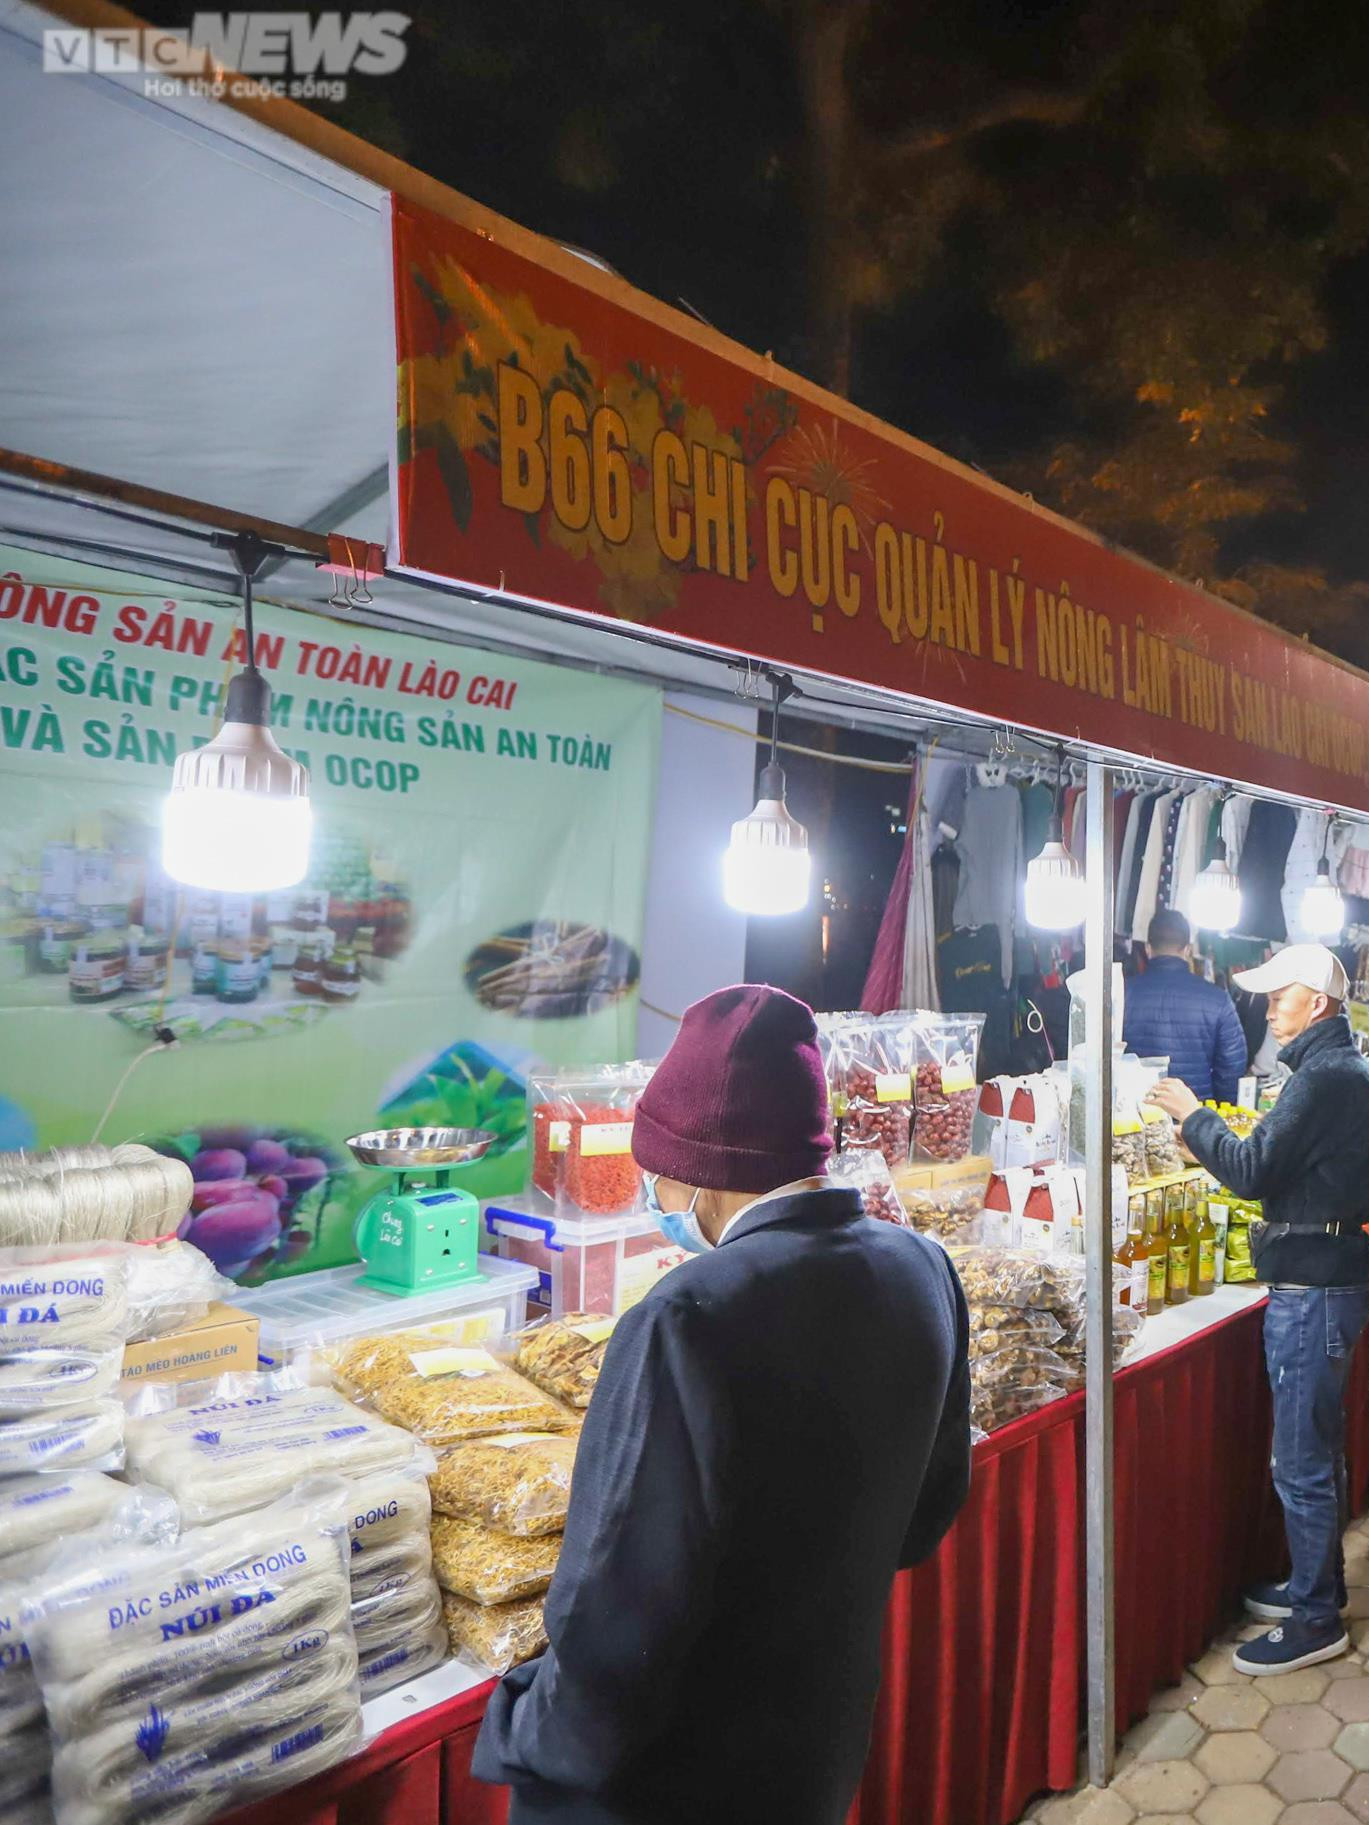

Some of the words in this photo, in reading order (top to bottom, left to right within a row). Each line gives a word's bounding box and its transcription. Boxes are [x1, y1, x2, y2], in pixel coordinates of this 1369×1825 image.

[498, 360, 632, 545] B66
[653, 429, 748, 582] CHI
[766, 477, 861, 633] CỤC
[874, 511, 981, 657] QUẢN
[989, 557, 1025, 671] LÝ
[1035, 580, 1115, 700] NÔNG
[1120, 614, 1172, 719] LÂM
[113, 600, 214, 657] SẢN
[221, 627, 285, 670] AN
[297, 641, 392, 690] TOÀN
[397, 658, 460, 700] LÀO
[466, 675, 517, 710] CAI
[1, 704, 64, 753] VÀ
[82, 713, 177, 770] SẢN
[56, 650, 155, 706] SẢN
[170, 675, 294, 728] PHM
[304, 697, 406, 743] NÔNG
[417, 708, 485, 753] SẢN
[496, 727, 538, 760] AN
[546, 732, 612, 771] TOÀN
[325, 754, 420, 794] OCOP
[52, 1278, 104, 1297] DONG
[355, 1501, 398, 1530] DONG
[108, 1598, 152, 1631] ĐẶC
[159, 1580, 200, 1609] SẢN
[252, 1545, 308, 1577] DONG
[159, 1604, 222, 1643] NÚI
